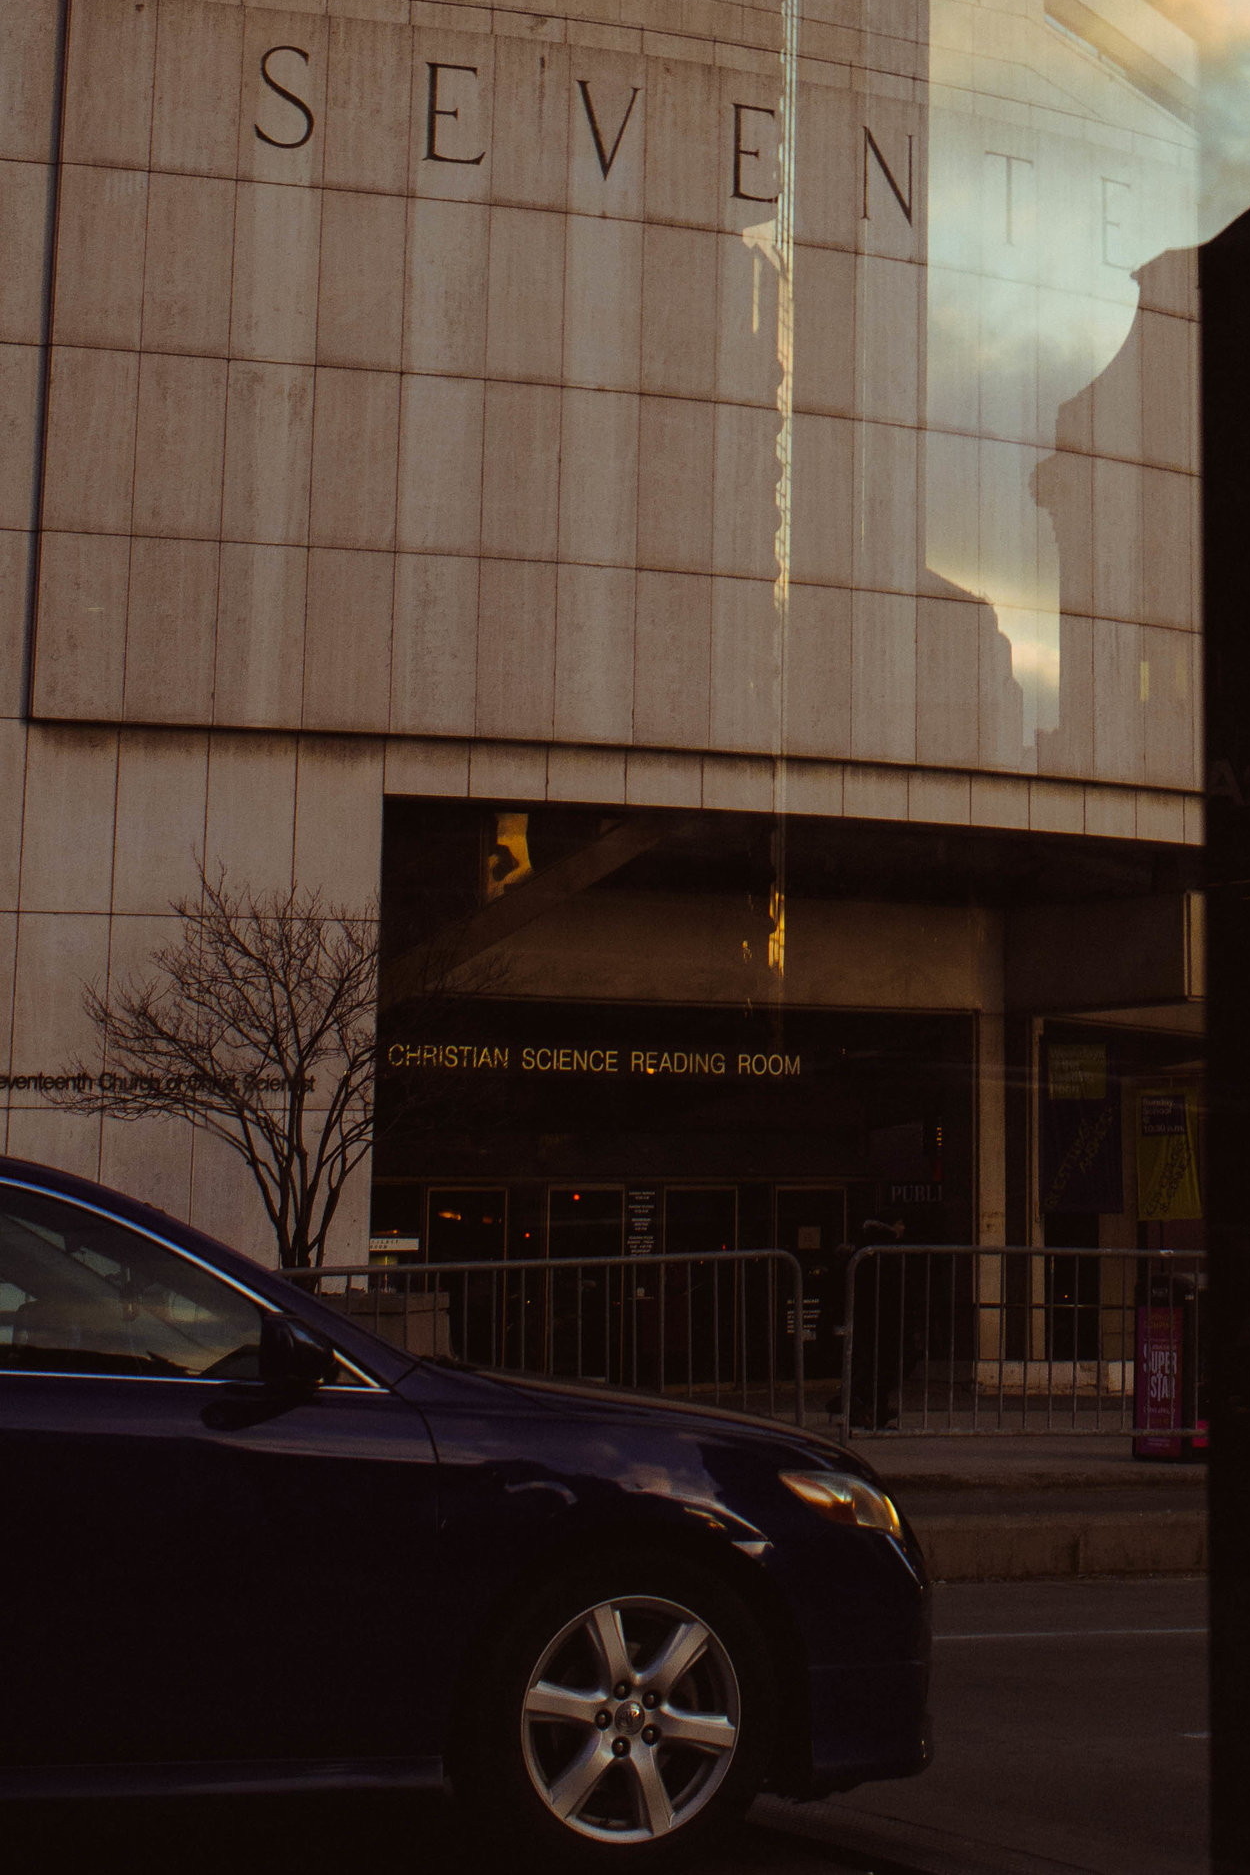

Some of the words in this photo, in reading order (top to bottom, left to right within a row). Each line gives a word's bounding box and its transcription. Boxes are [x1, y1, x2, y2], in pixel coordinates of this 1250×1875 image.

[387, 1044, 510, 1070] CHRISTIAN
[522, 1048, 619, 1072] SCIENCE
[631, 1051, 726, 1074] READING
[738, 1053, 801, 1076] ROOM
[244, 1072, 315, 1092] Scienst
